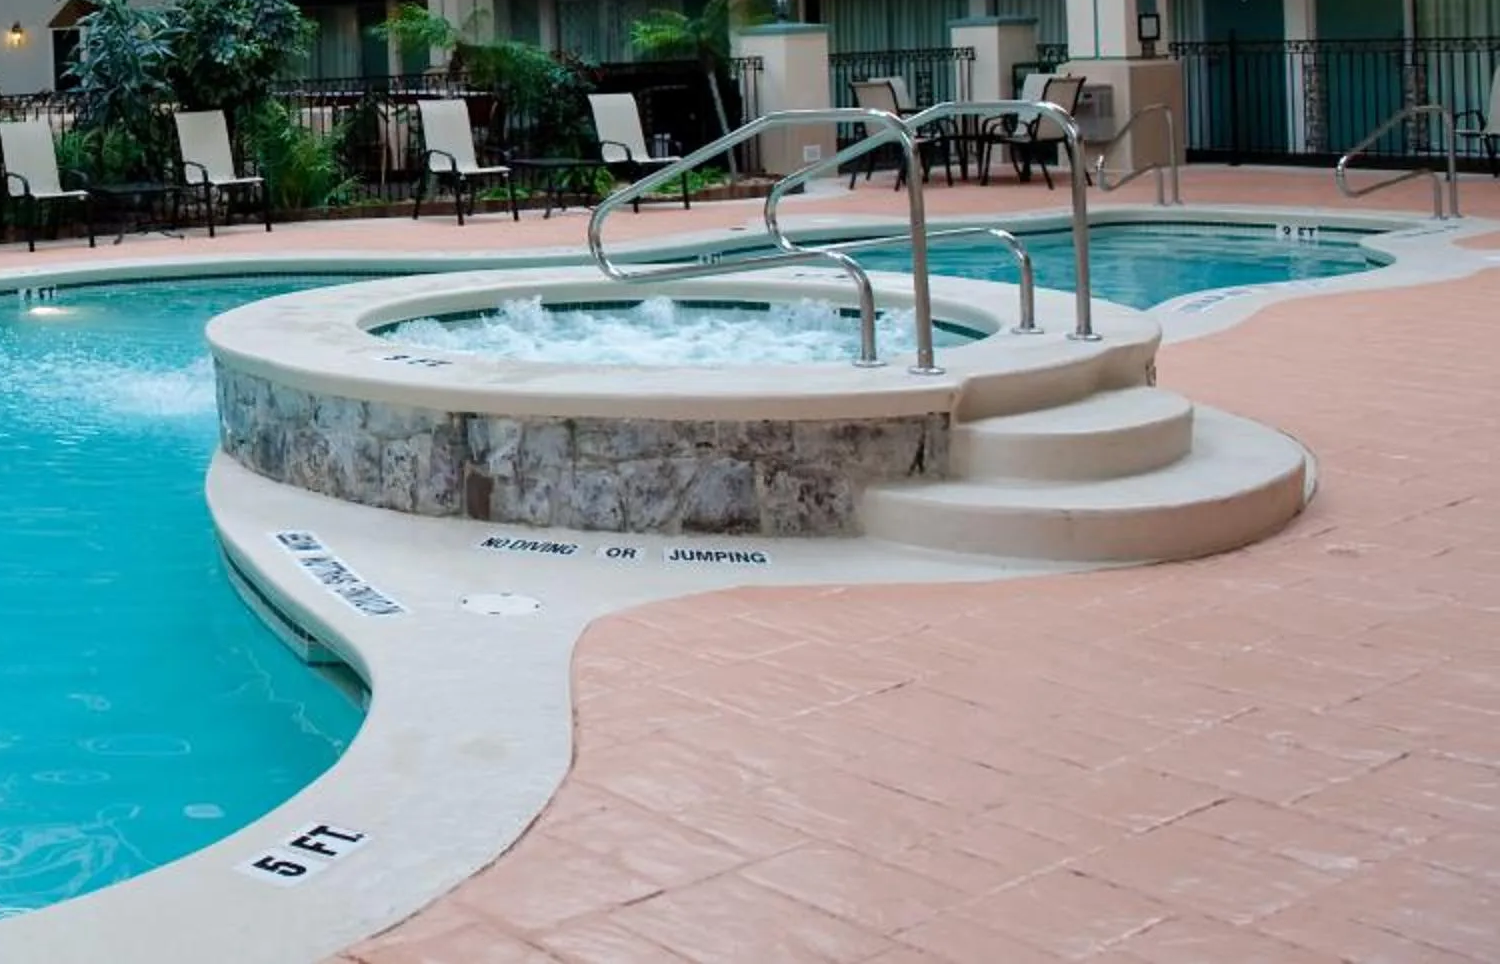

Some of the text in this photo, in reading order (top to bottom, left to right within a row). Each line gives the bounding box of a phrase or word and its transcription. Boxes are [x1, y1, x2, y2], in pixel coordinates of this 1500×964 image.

[480, 537, 767, 564] NO DIVING OR JUMPING
[251, 824, 365, 877] 5 FT
